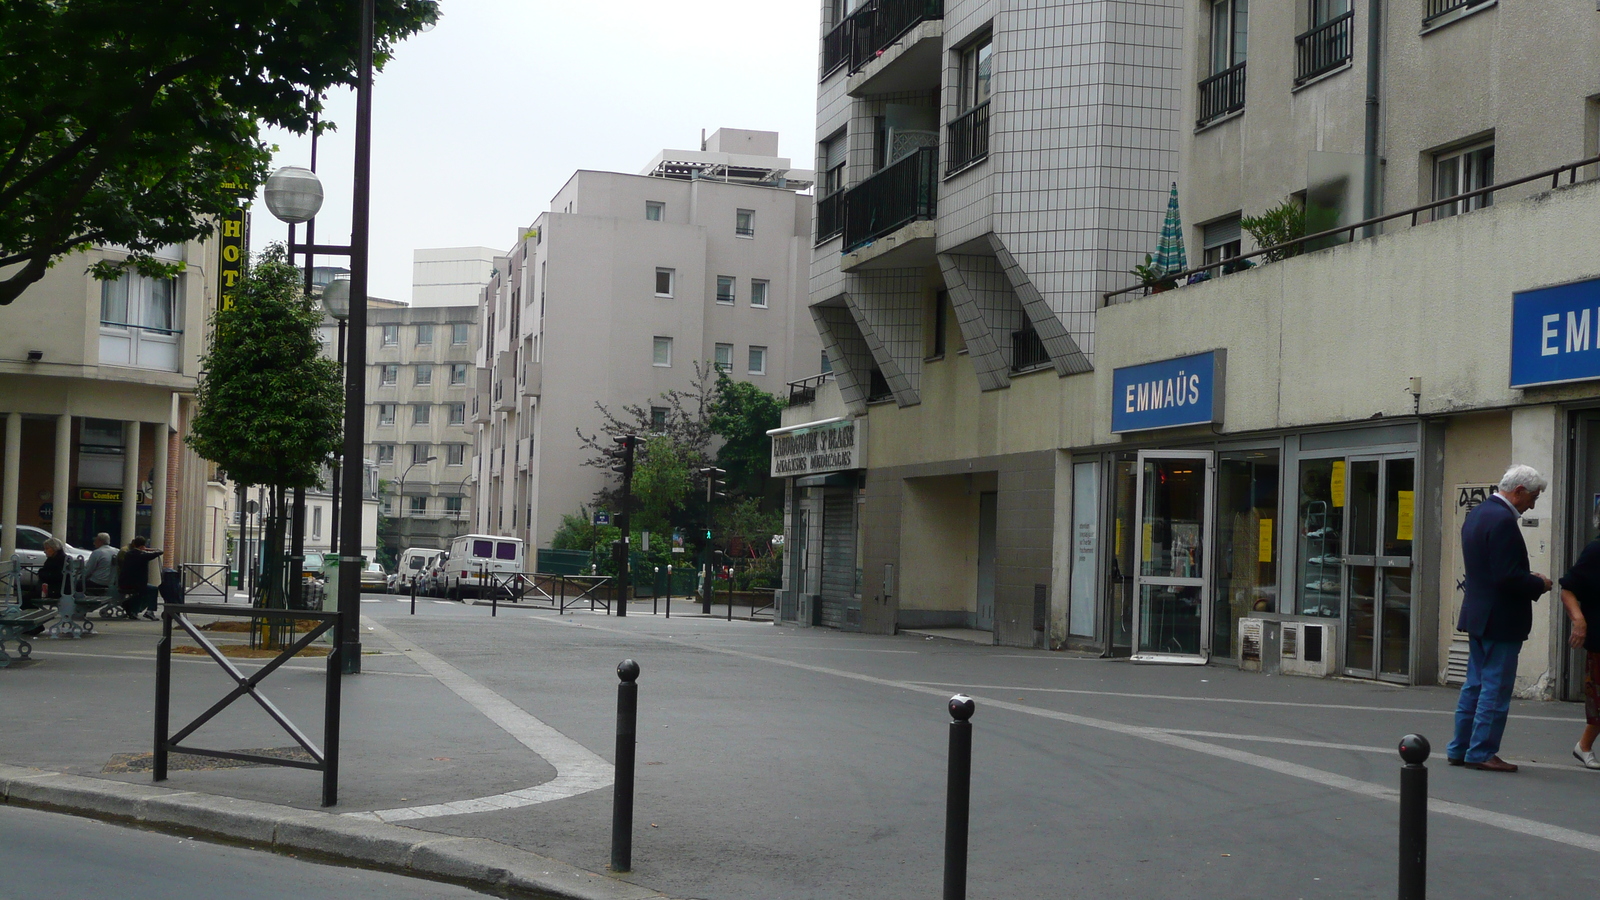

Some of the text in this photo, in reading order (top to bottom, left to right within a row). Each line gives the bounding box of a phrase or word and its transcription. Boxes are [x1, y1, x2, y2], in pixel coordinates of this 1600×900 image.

[222, 220, 241, 336] HOTE
[1541, 306, 1600, 356] EM
[1126, 370, 1199, 413] EMMAÜS
[774, 431, 818, 456] LABORATOIRE
[828, 424, 855, 449] BLAISE
[775, 456, 807, 473] ANALYSES
[92, 491, 120, 500] Comfort
